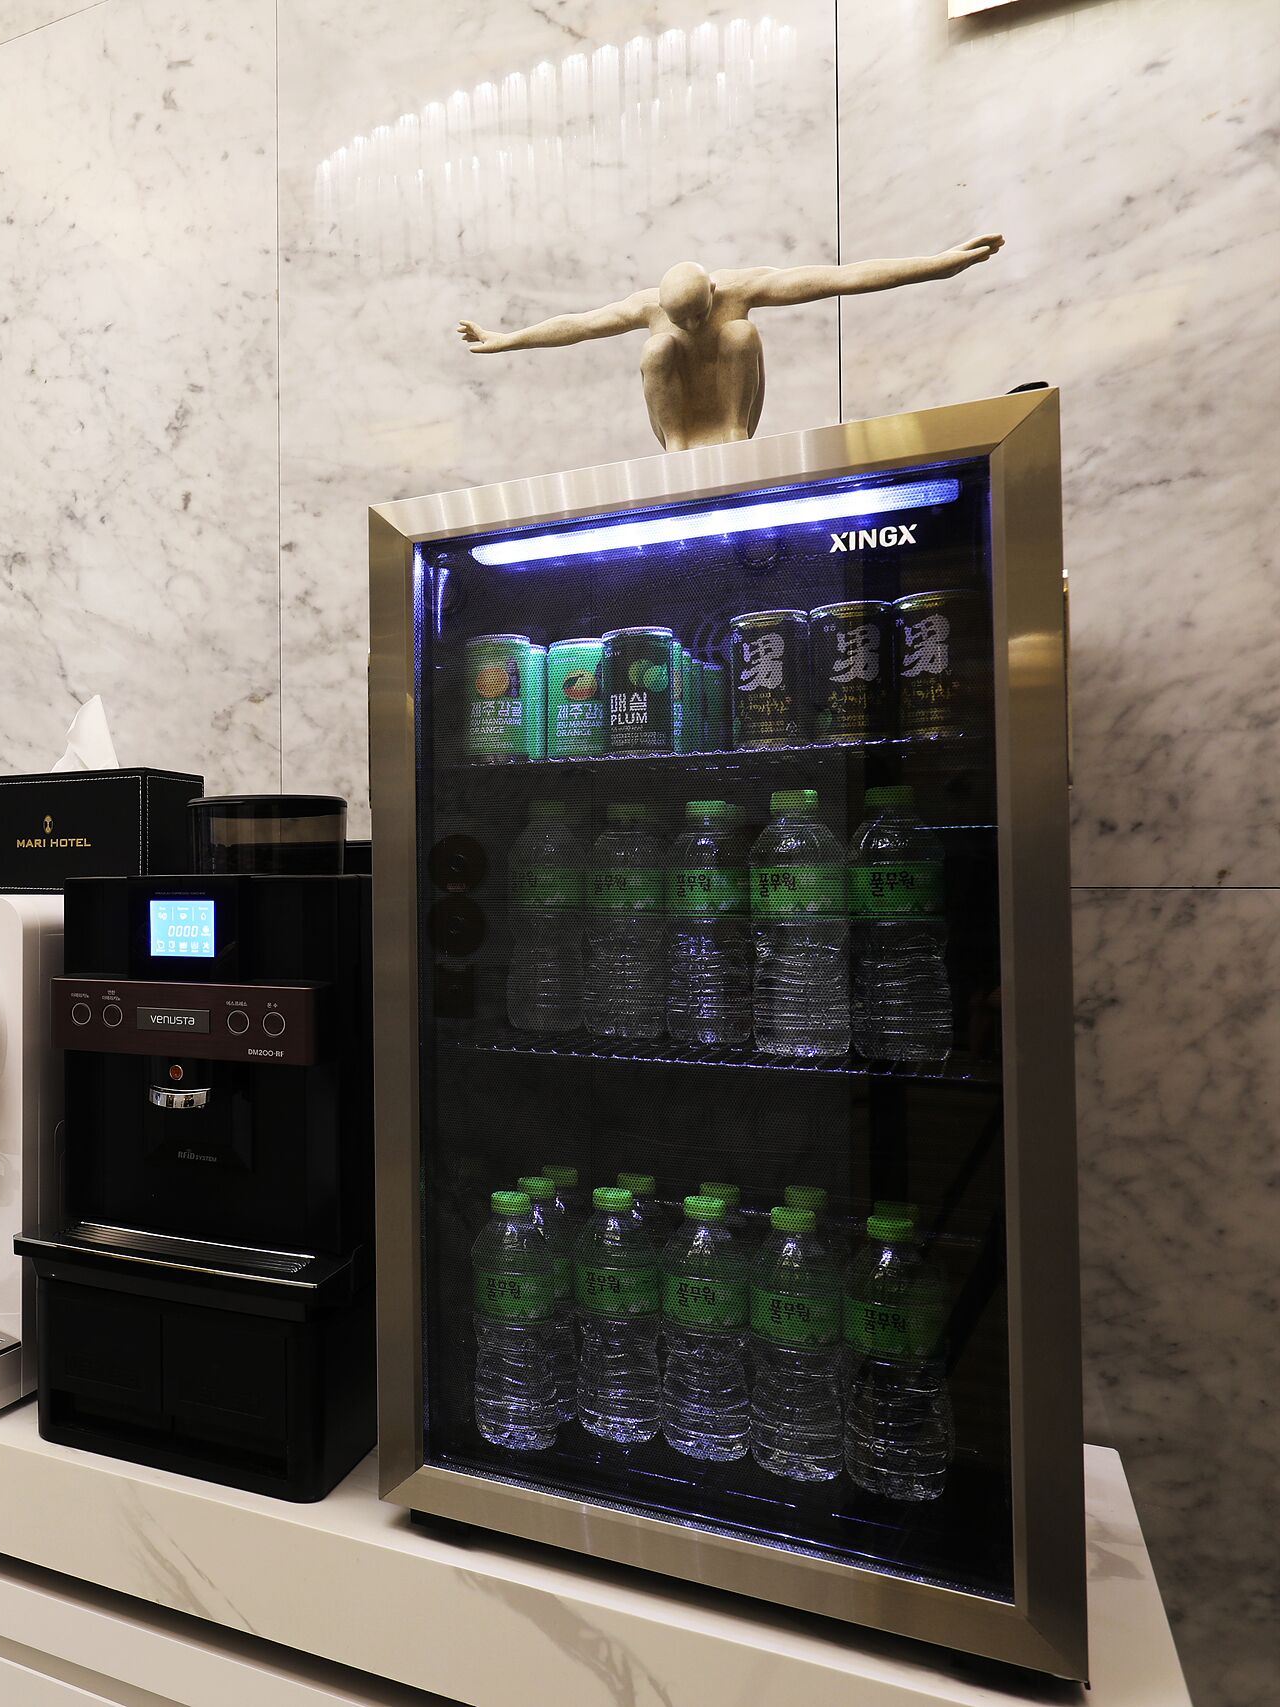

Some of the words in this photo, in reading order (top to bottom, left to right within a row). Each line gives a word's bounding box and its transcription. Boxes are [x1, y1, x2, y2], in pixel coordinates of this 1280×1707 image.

[829, 523, 918, 553] XINGX
[829, 623, 880, 683] 男
[900, 613, 951, 678] 男
[738, 632, 785, 691] 男
[610, 711, 648, 726] PLUM
[16, 838, 46, 848] MARI
[50, 838, 92, 848] HOTEL
[871, 870, 915, 898] 풀무원
[167, 924, 200, 938] 0000
[679, 1281, 716, 1307] 풀무원
[864, 1308, 909, 1335] 풀무원
